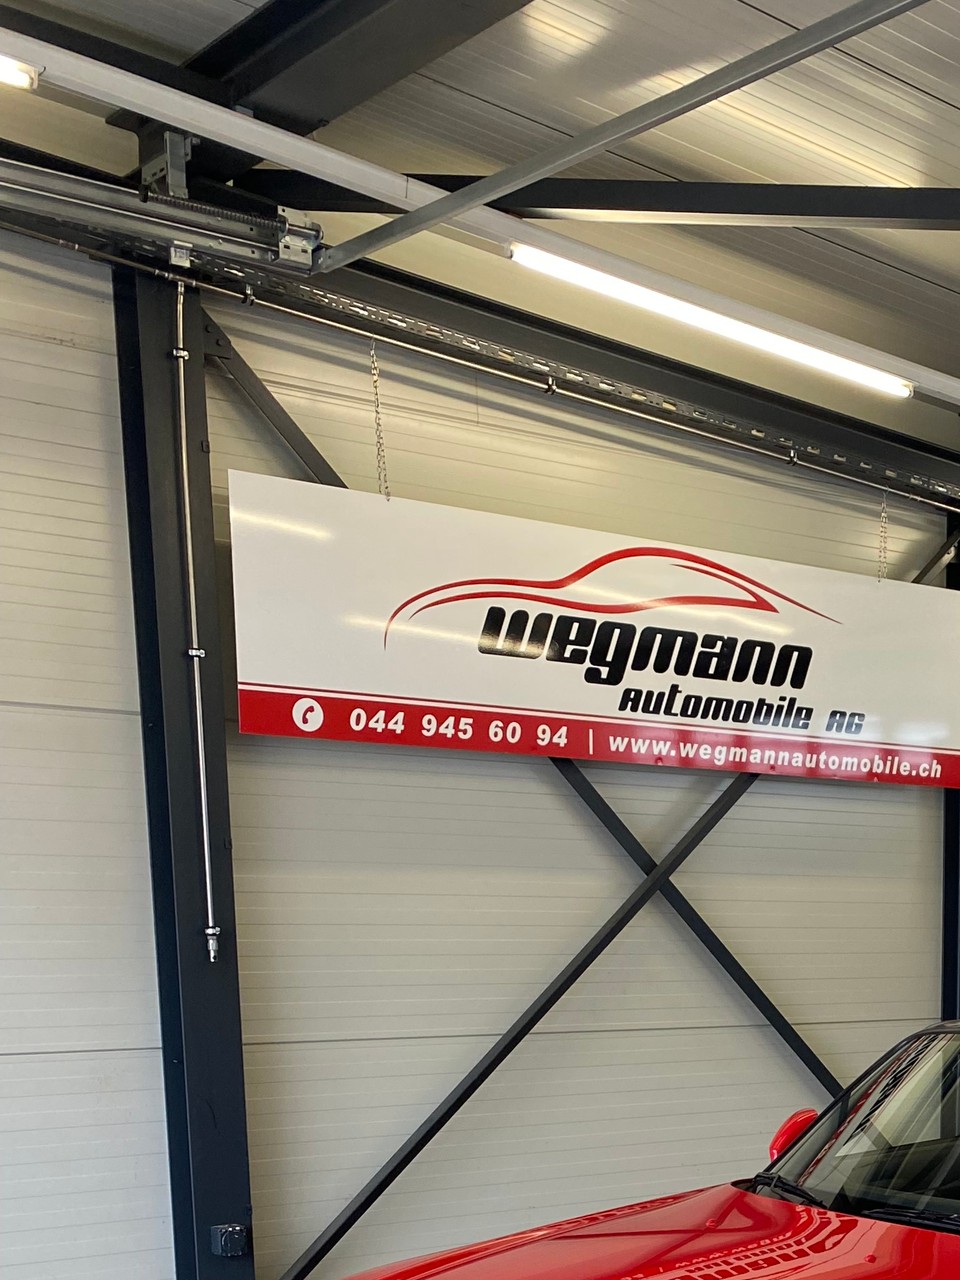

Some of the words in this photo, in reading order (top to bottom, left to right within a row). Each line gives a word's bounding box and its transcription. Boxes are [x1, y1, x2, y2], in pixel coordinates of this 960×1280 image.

[478, 606, 813, 690] wegmann
[350, 708, 405, 734] 044
[421, 714, 473, 740] 945
[488, 720, 522, 743] 60
[536, 724, 568, 747] 94
[608, 735, 943, 779] www.wegmannautomobile.ch
[618, 684, 814, 730] Automobile
[825, 710, 866, 735] AG
